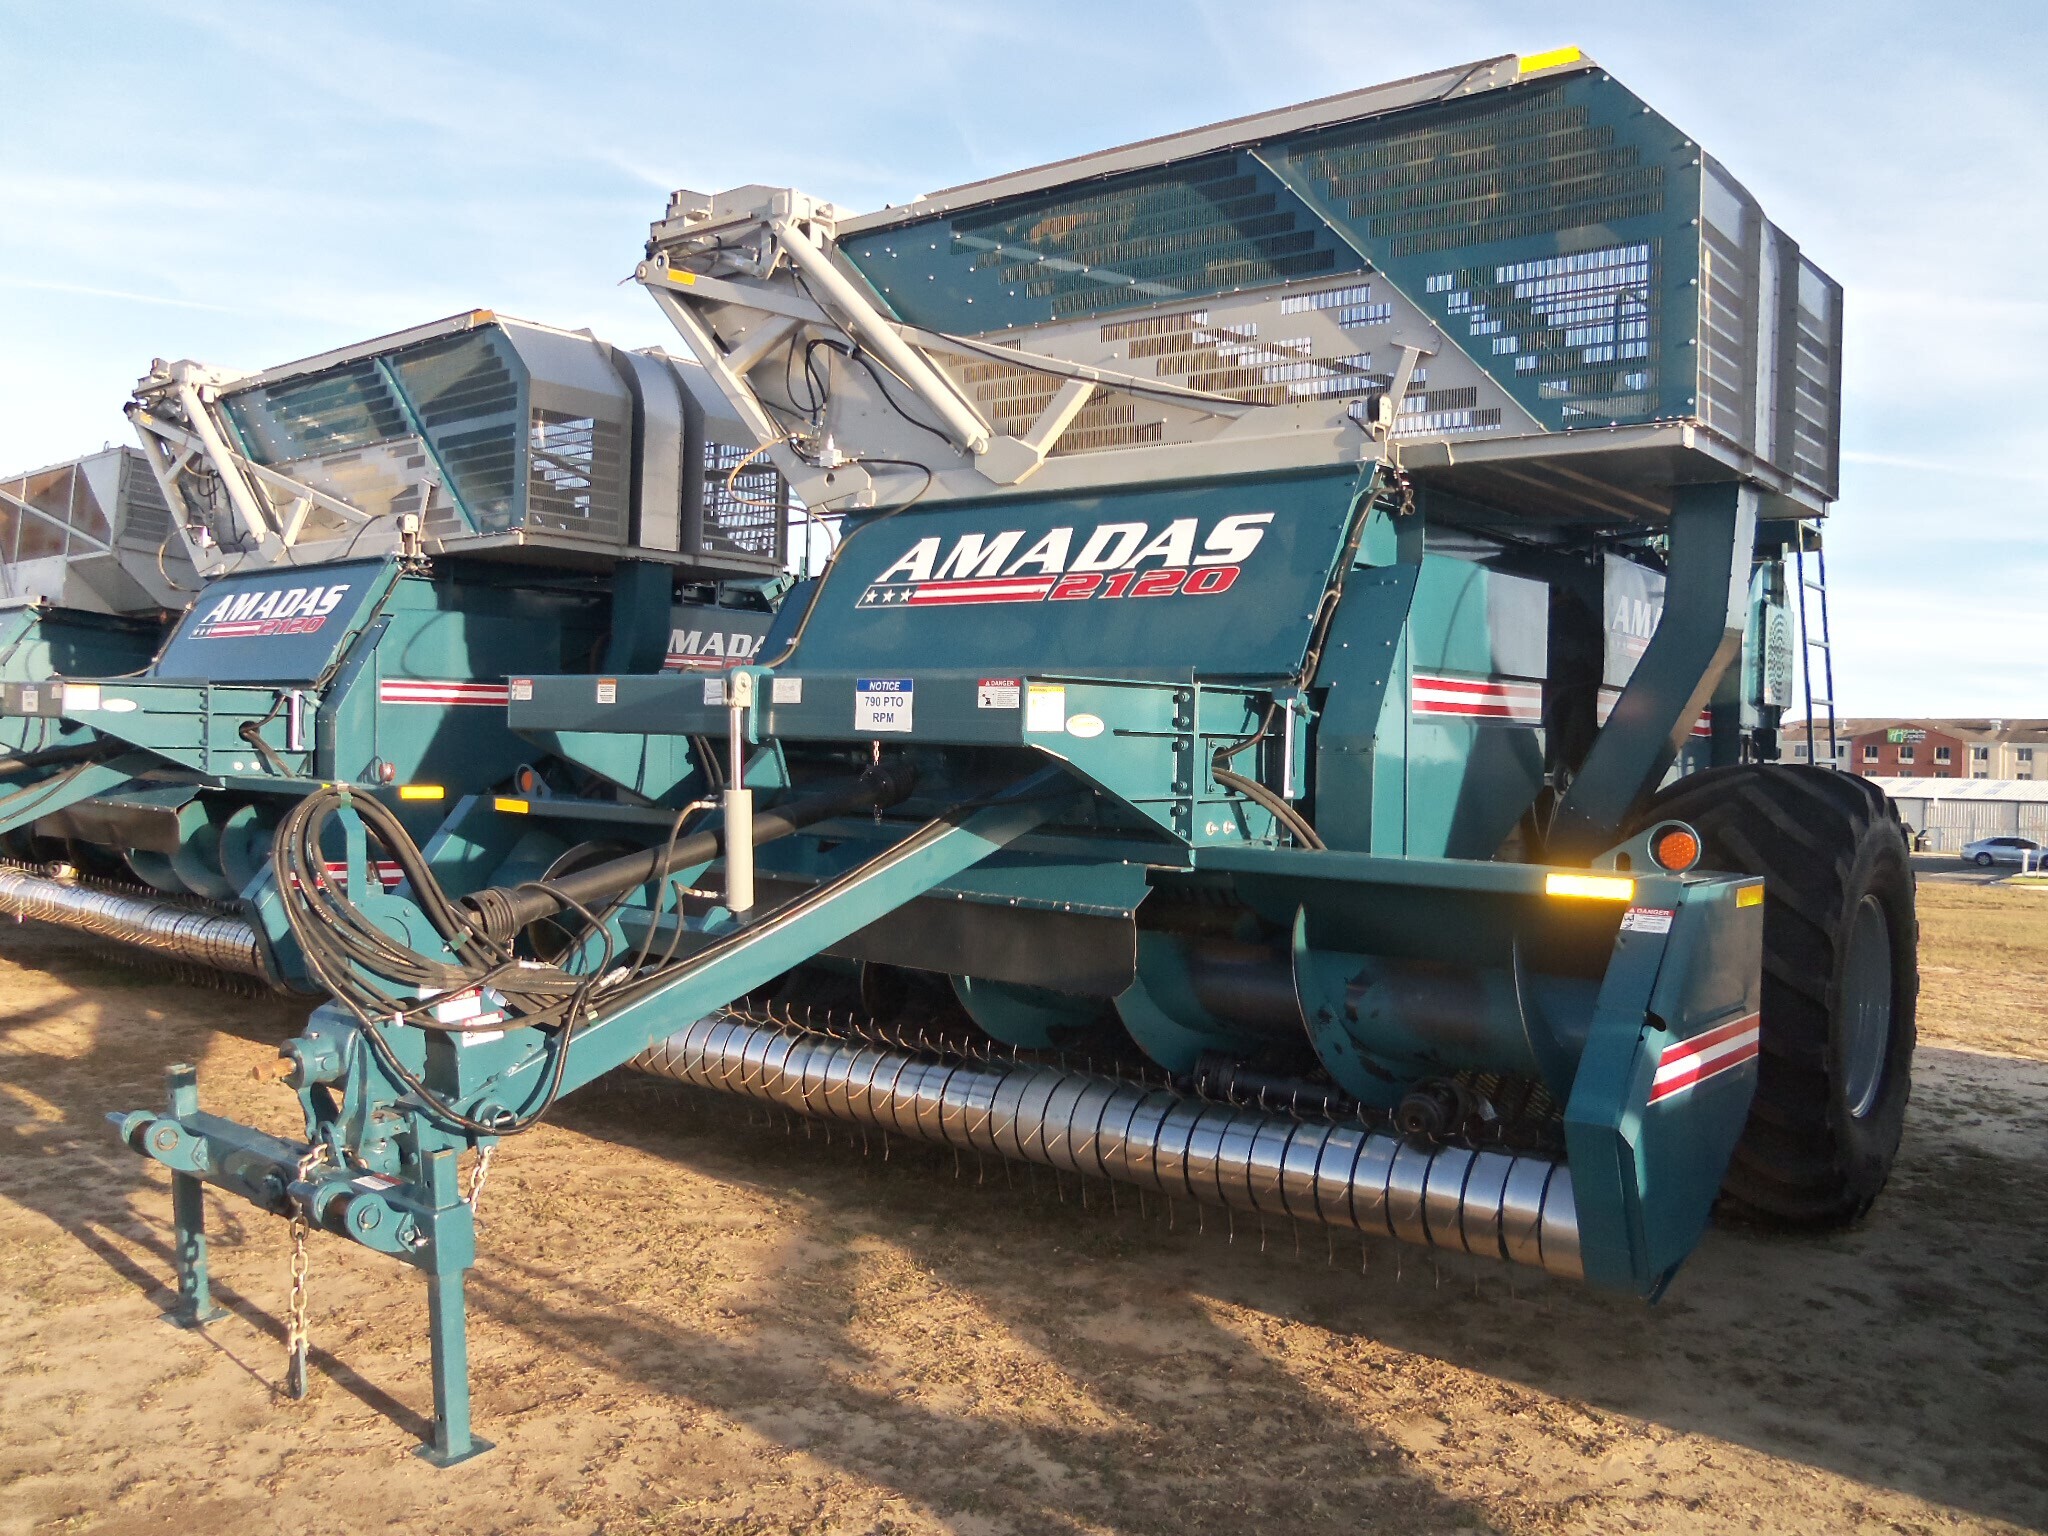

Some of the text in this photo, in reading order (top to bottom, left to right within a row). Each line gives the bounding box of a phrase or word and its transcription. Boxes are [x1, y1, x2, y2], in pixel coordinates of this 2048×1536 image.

[874, 512, 1275, 582] AMADAS
[1048, 566, 1241, 601] 2120
[201, 584, 351, 623] AMADAS
[255, 615, 328, 636] 2120
[870, 681, 901, 691] NOTICE
[990, 679, 1015, 687] DANGER
[865, 696, 904, 707] 790 PTO
[872, 712, 894, 723] RPM
[1636, 908, 1670, 916] DANGER
